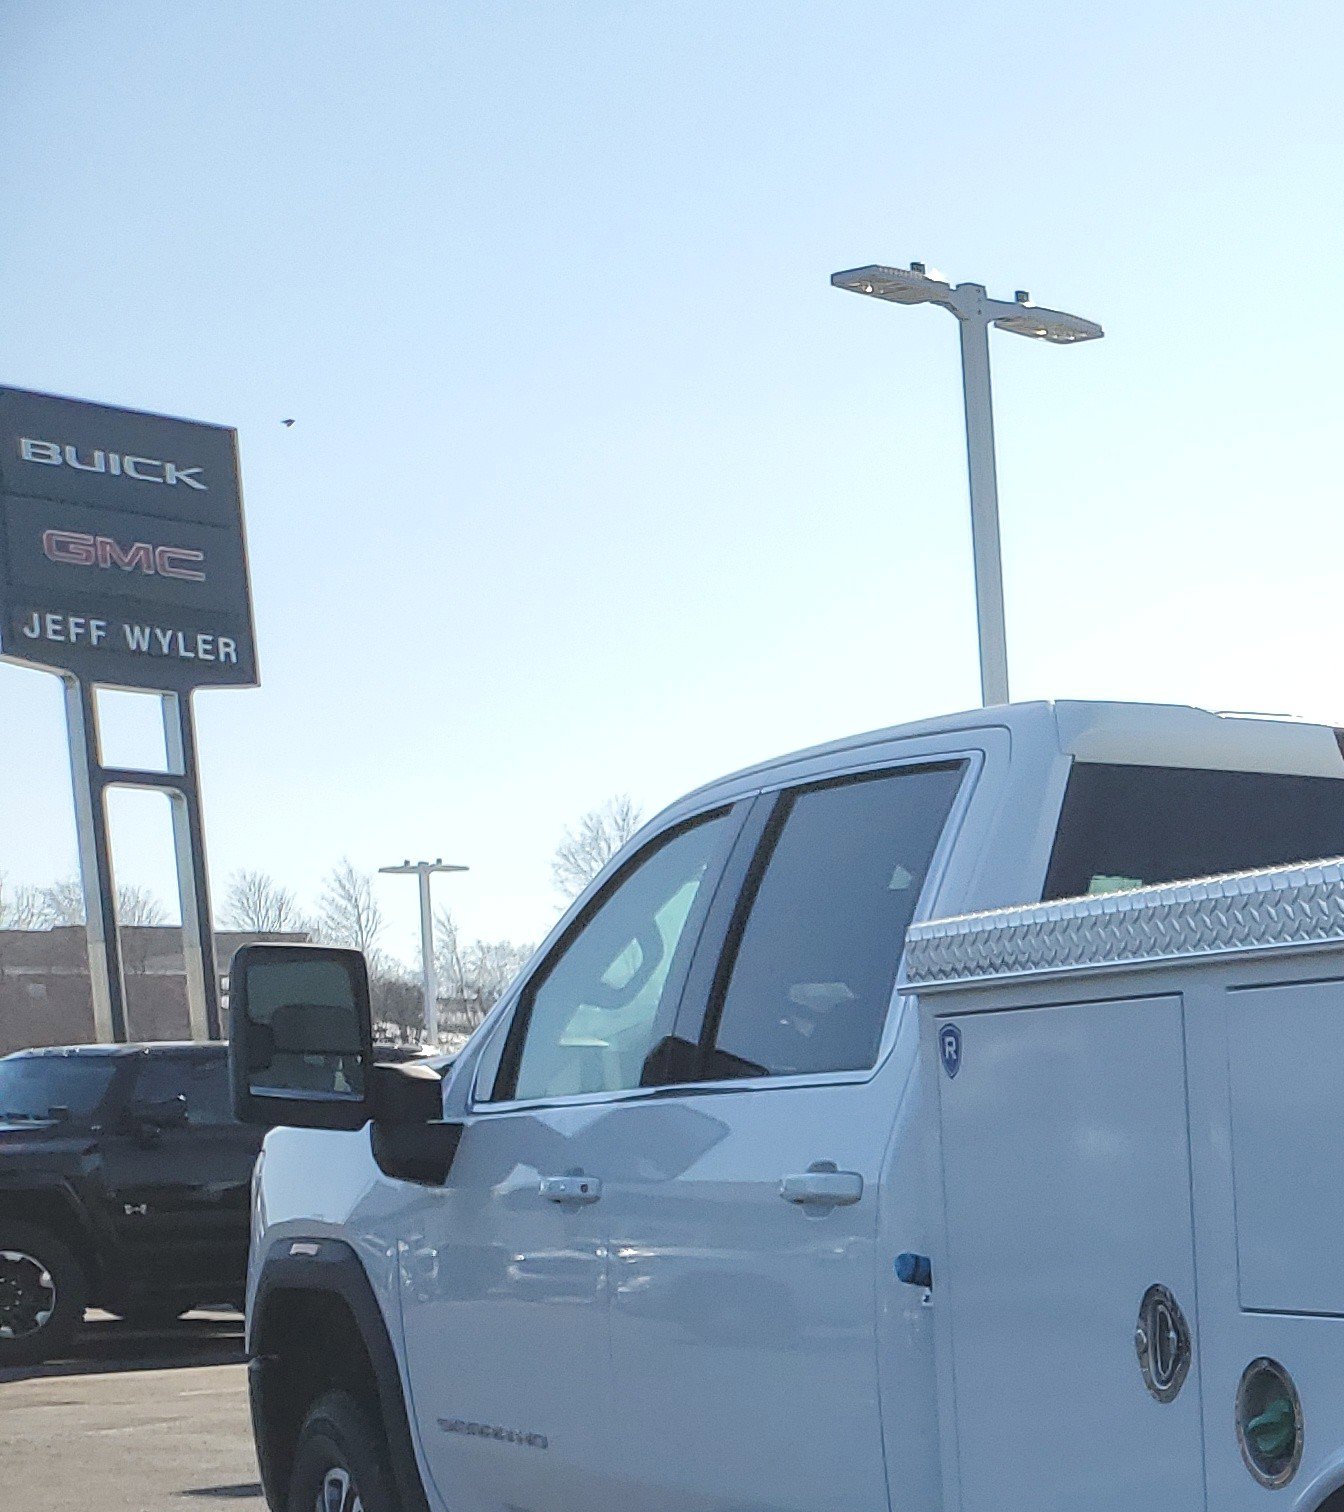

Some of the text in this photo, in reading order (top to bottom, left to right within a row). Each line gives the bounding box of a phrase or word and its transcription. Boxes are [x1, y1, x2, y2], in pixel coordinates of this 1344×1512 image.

[20, 437, 208, 490] BUICK
[42, 529, 206, 582] GMC
[23, 612, 238, 664] JEFF WYLER
